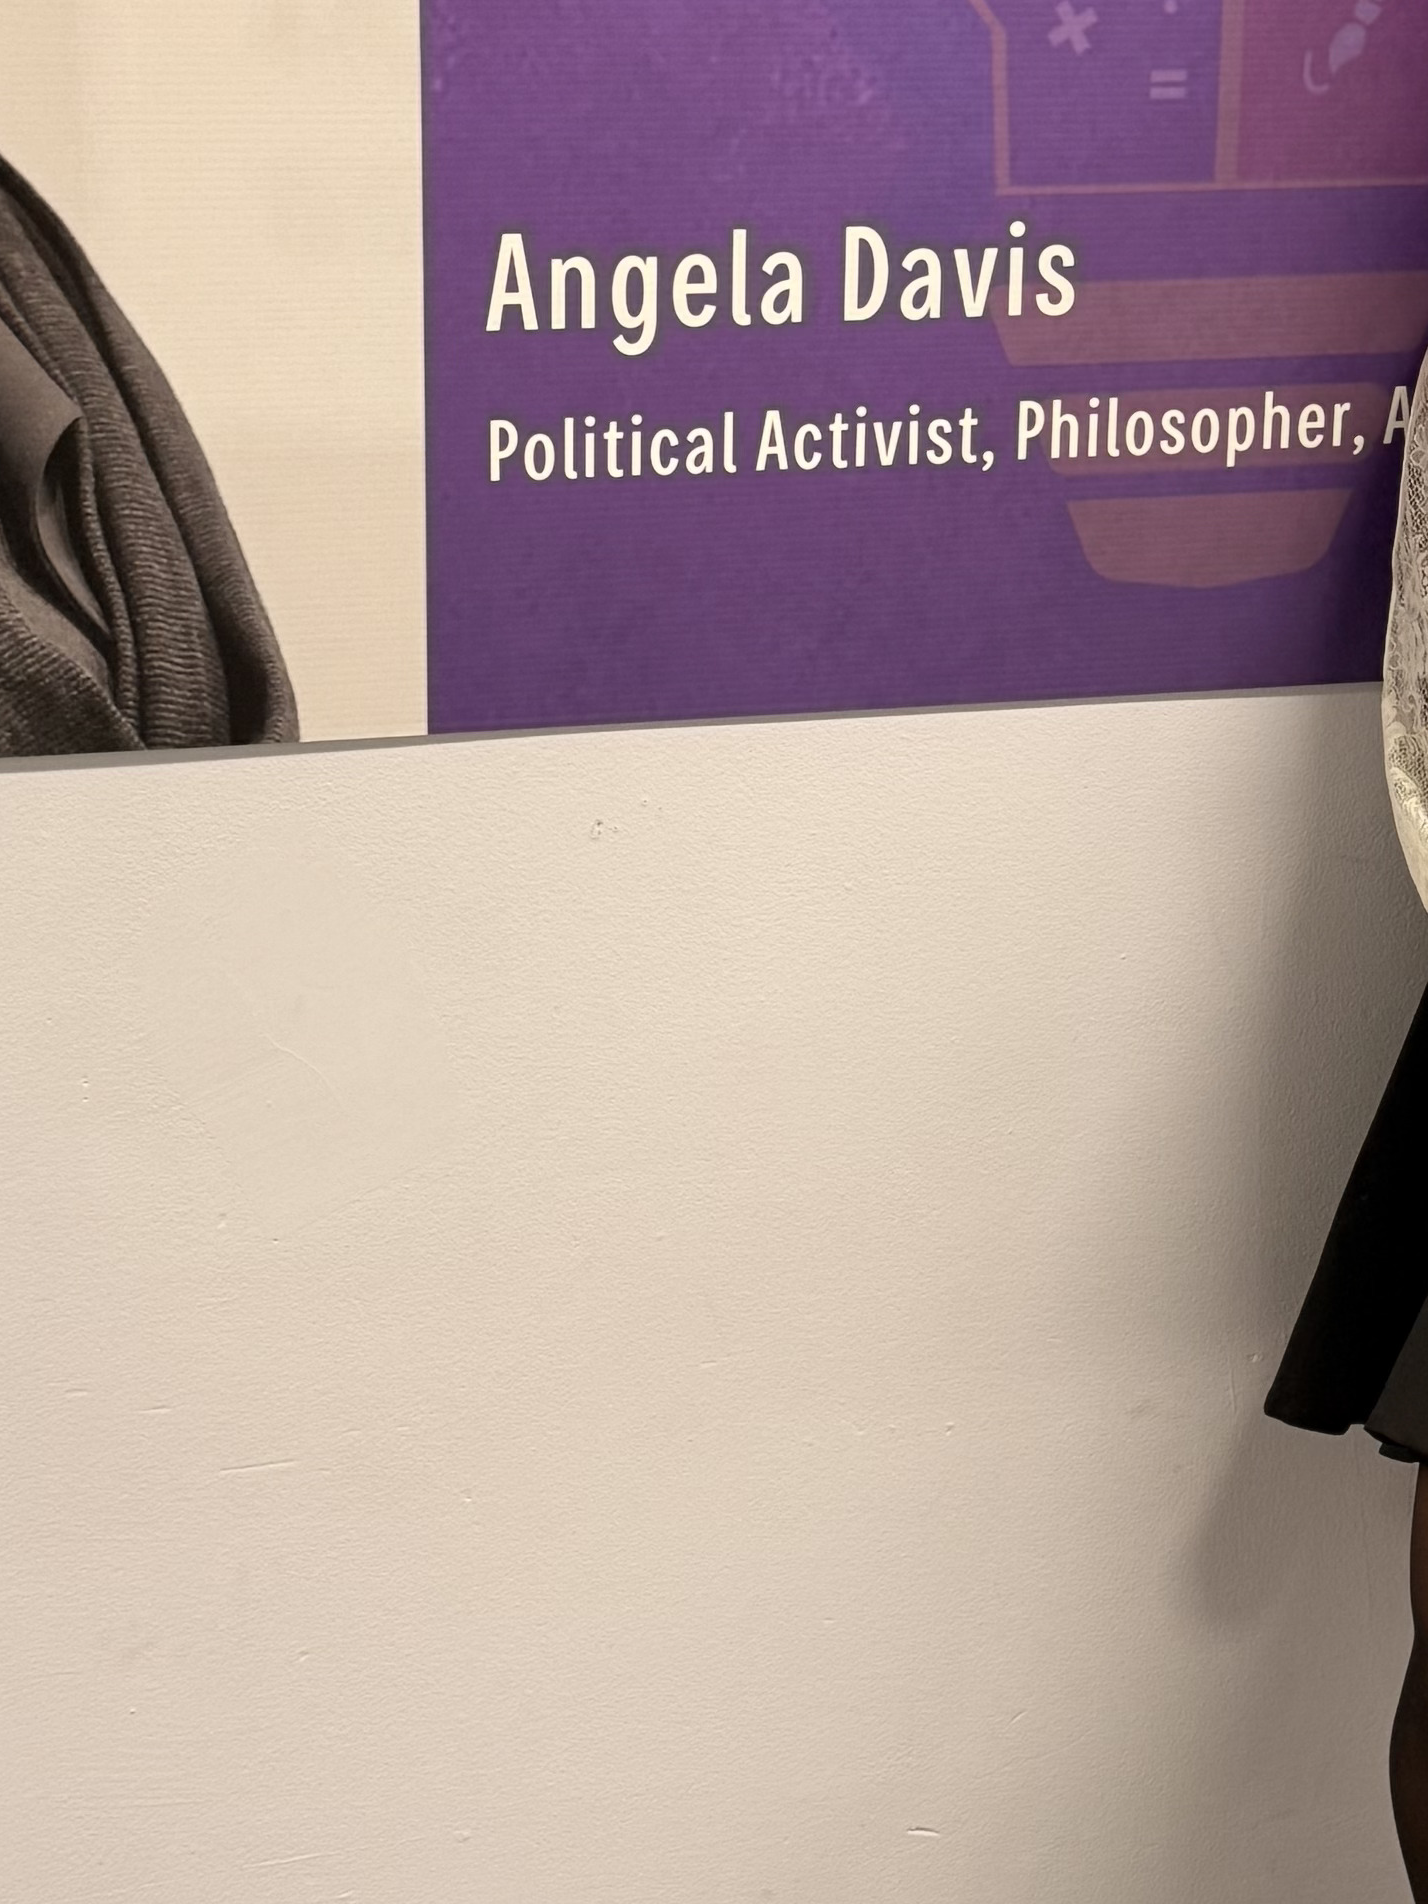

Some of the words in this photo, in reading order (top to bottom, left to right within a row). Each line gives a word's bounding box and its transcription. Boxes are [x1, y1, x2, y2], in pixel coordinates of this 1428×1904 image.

[484, 227, 804, 357] Angela
[841, 219, 1076, 323] Davis
[488, 410, 738, 483] Political
[754, 402, 996, 473] Activist,
[1016, 389, 1366, 469] Philosopher,
